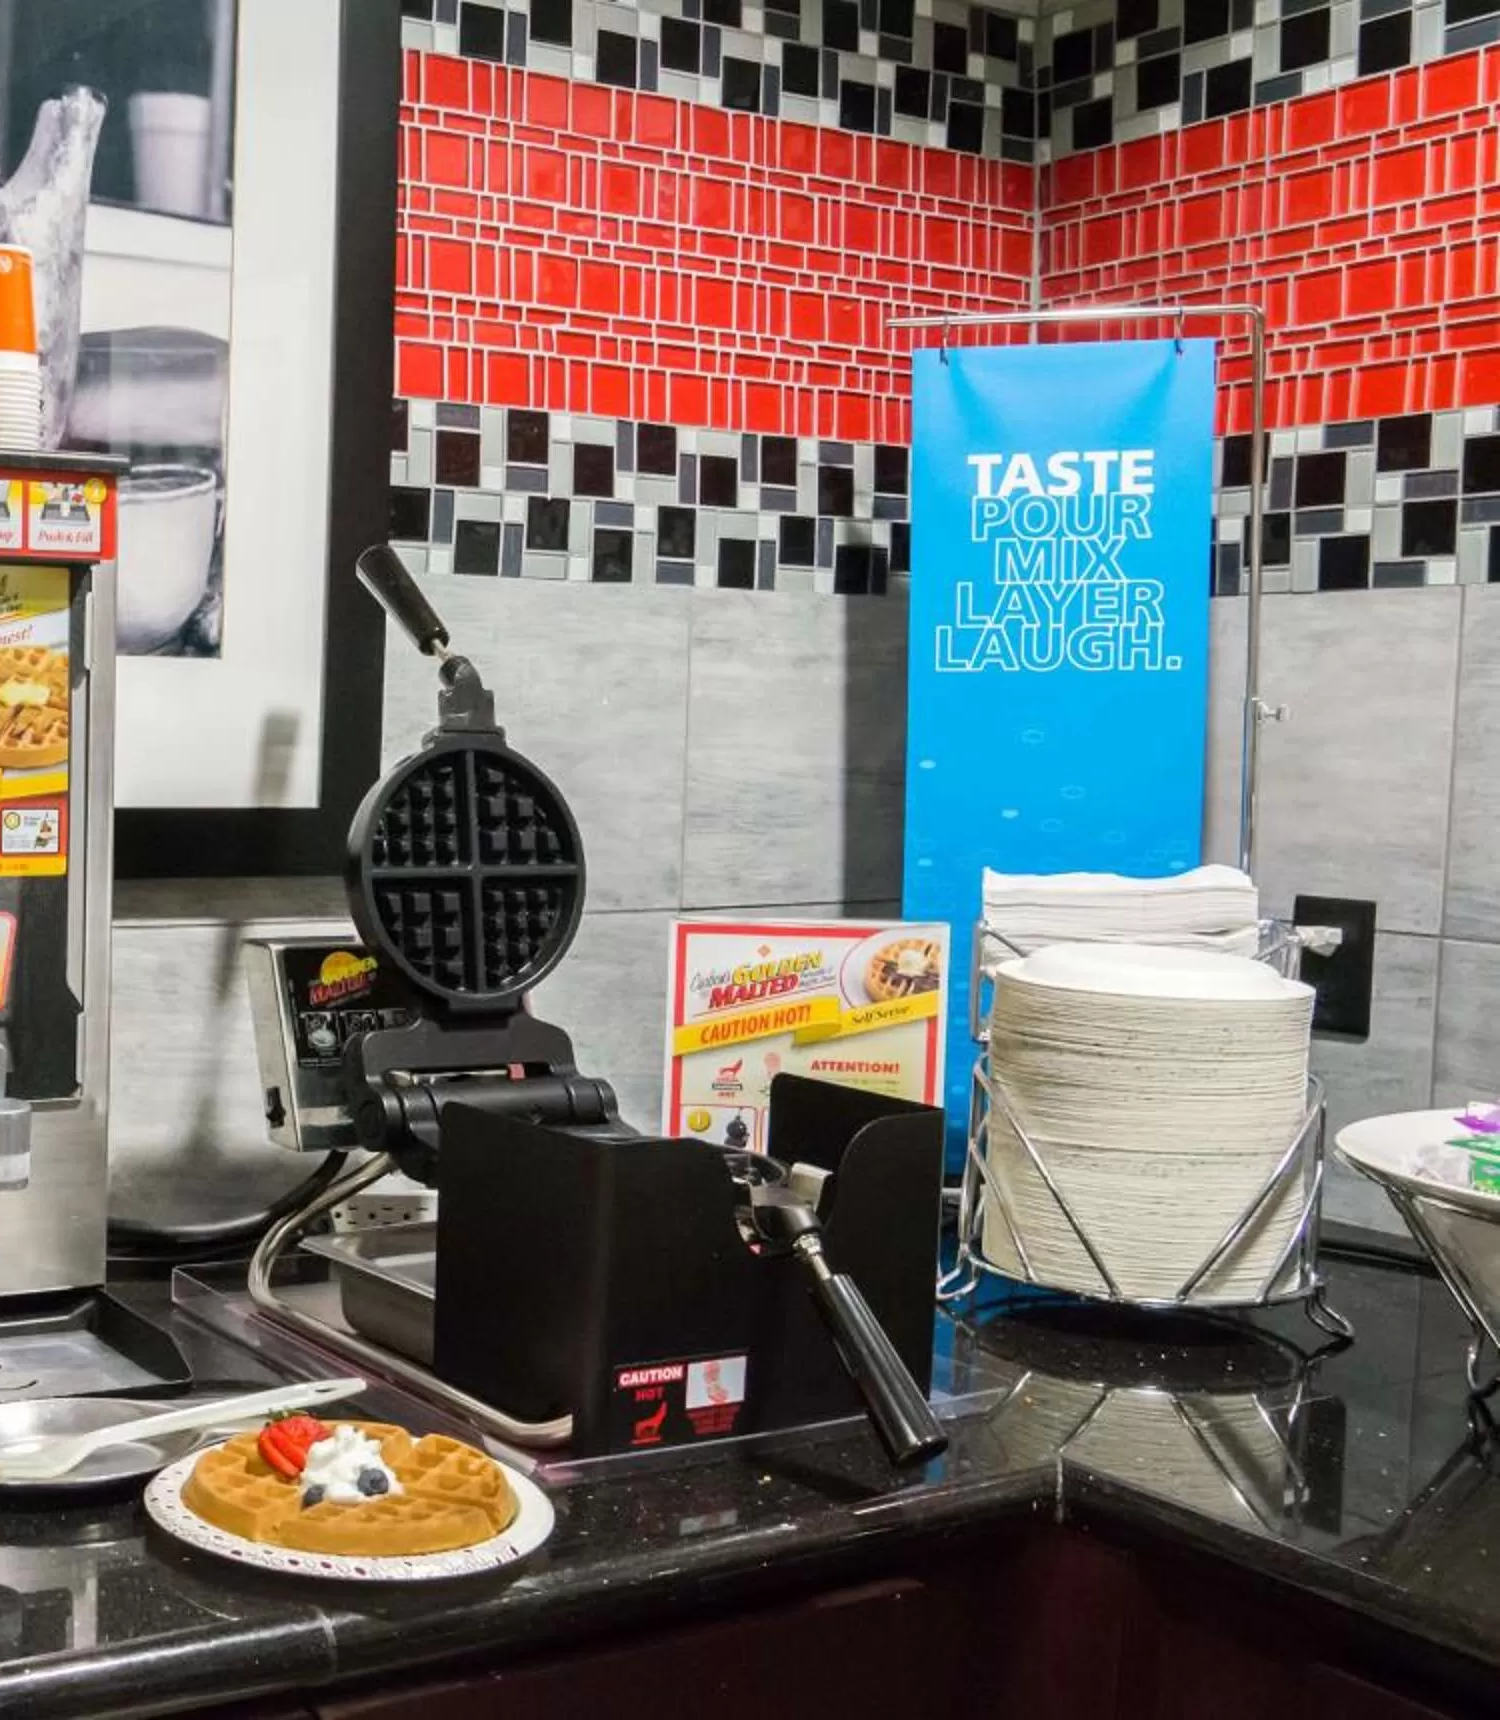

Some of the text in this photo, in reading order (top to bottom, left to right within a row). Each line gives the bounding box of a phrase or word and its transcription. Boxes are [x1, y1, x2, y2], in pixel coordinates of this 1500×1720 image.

[966, 449, 1155, 497] TASTE
[971, 492, 1153, 542] POUR
[995, 537, 1127, 584] MIX
[955, 579, 1165, 629] LAYER
[935, 624, 1183, 672] LAUGH.
[708, 974, 800, 1009] MALTED
[700, 1014, 770, 1045] CAUTION
[810, 1059, 901, 1075] ATTENTION!
[619, 1364, 684, 1387] CAUTION
[635, 1386, 665, 1401] HOT
